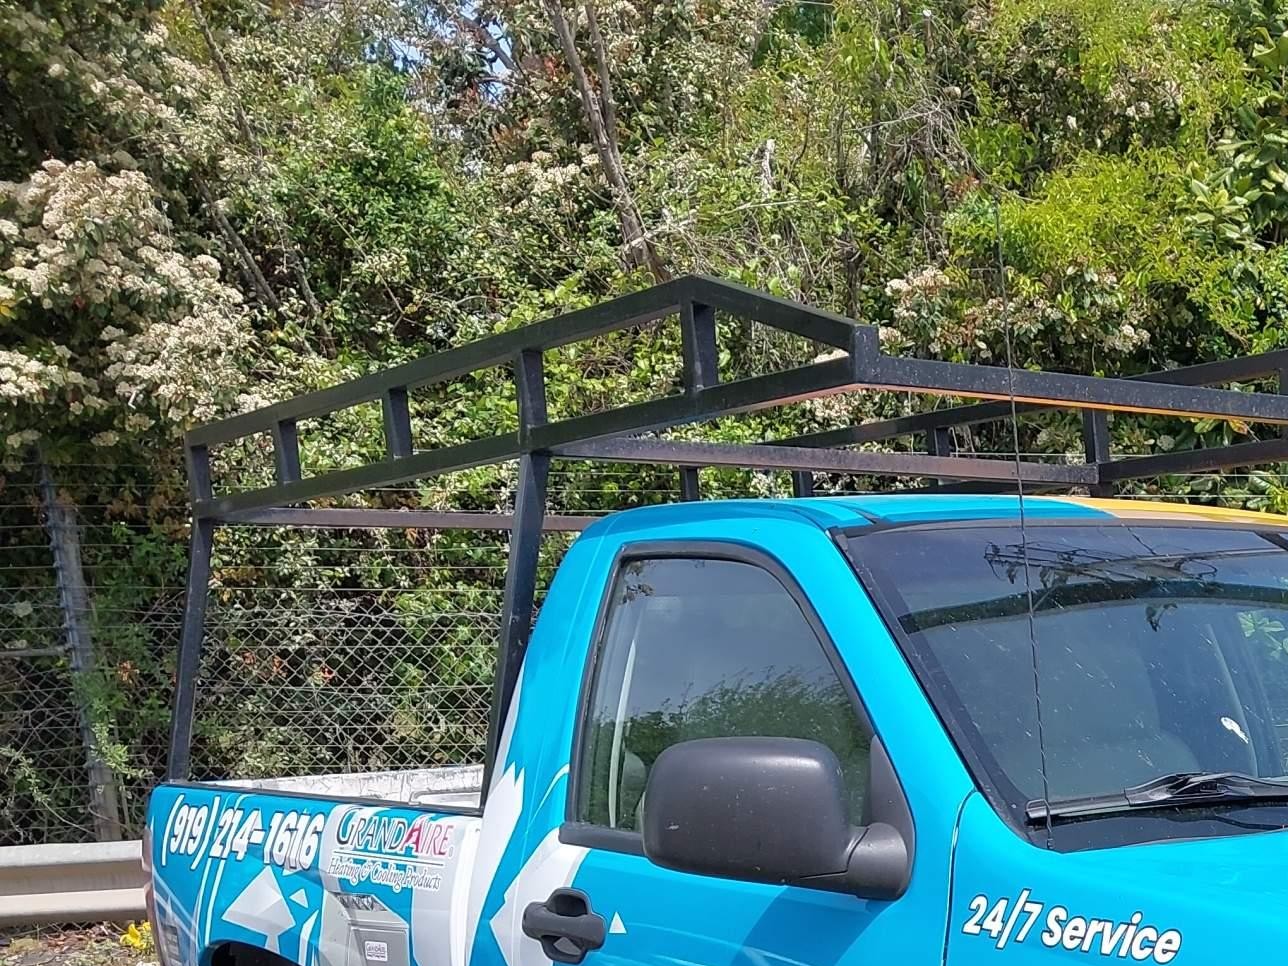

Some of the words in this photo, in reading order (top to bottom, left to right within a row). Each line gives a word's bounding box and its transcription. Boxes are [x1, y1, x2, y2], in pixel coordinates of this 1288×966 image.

[162, 794, 221, 870] (919)
[209, 808, 325, 870] 214-1616
[329, 857, 360, 882] Heating
[372, 863, 403, 890] Cooling
[404, 866, 441, 890] Products
[962, 888, 1044, 949] 24/7
[1041, 905, 1182, 964] Service
